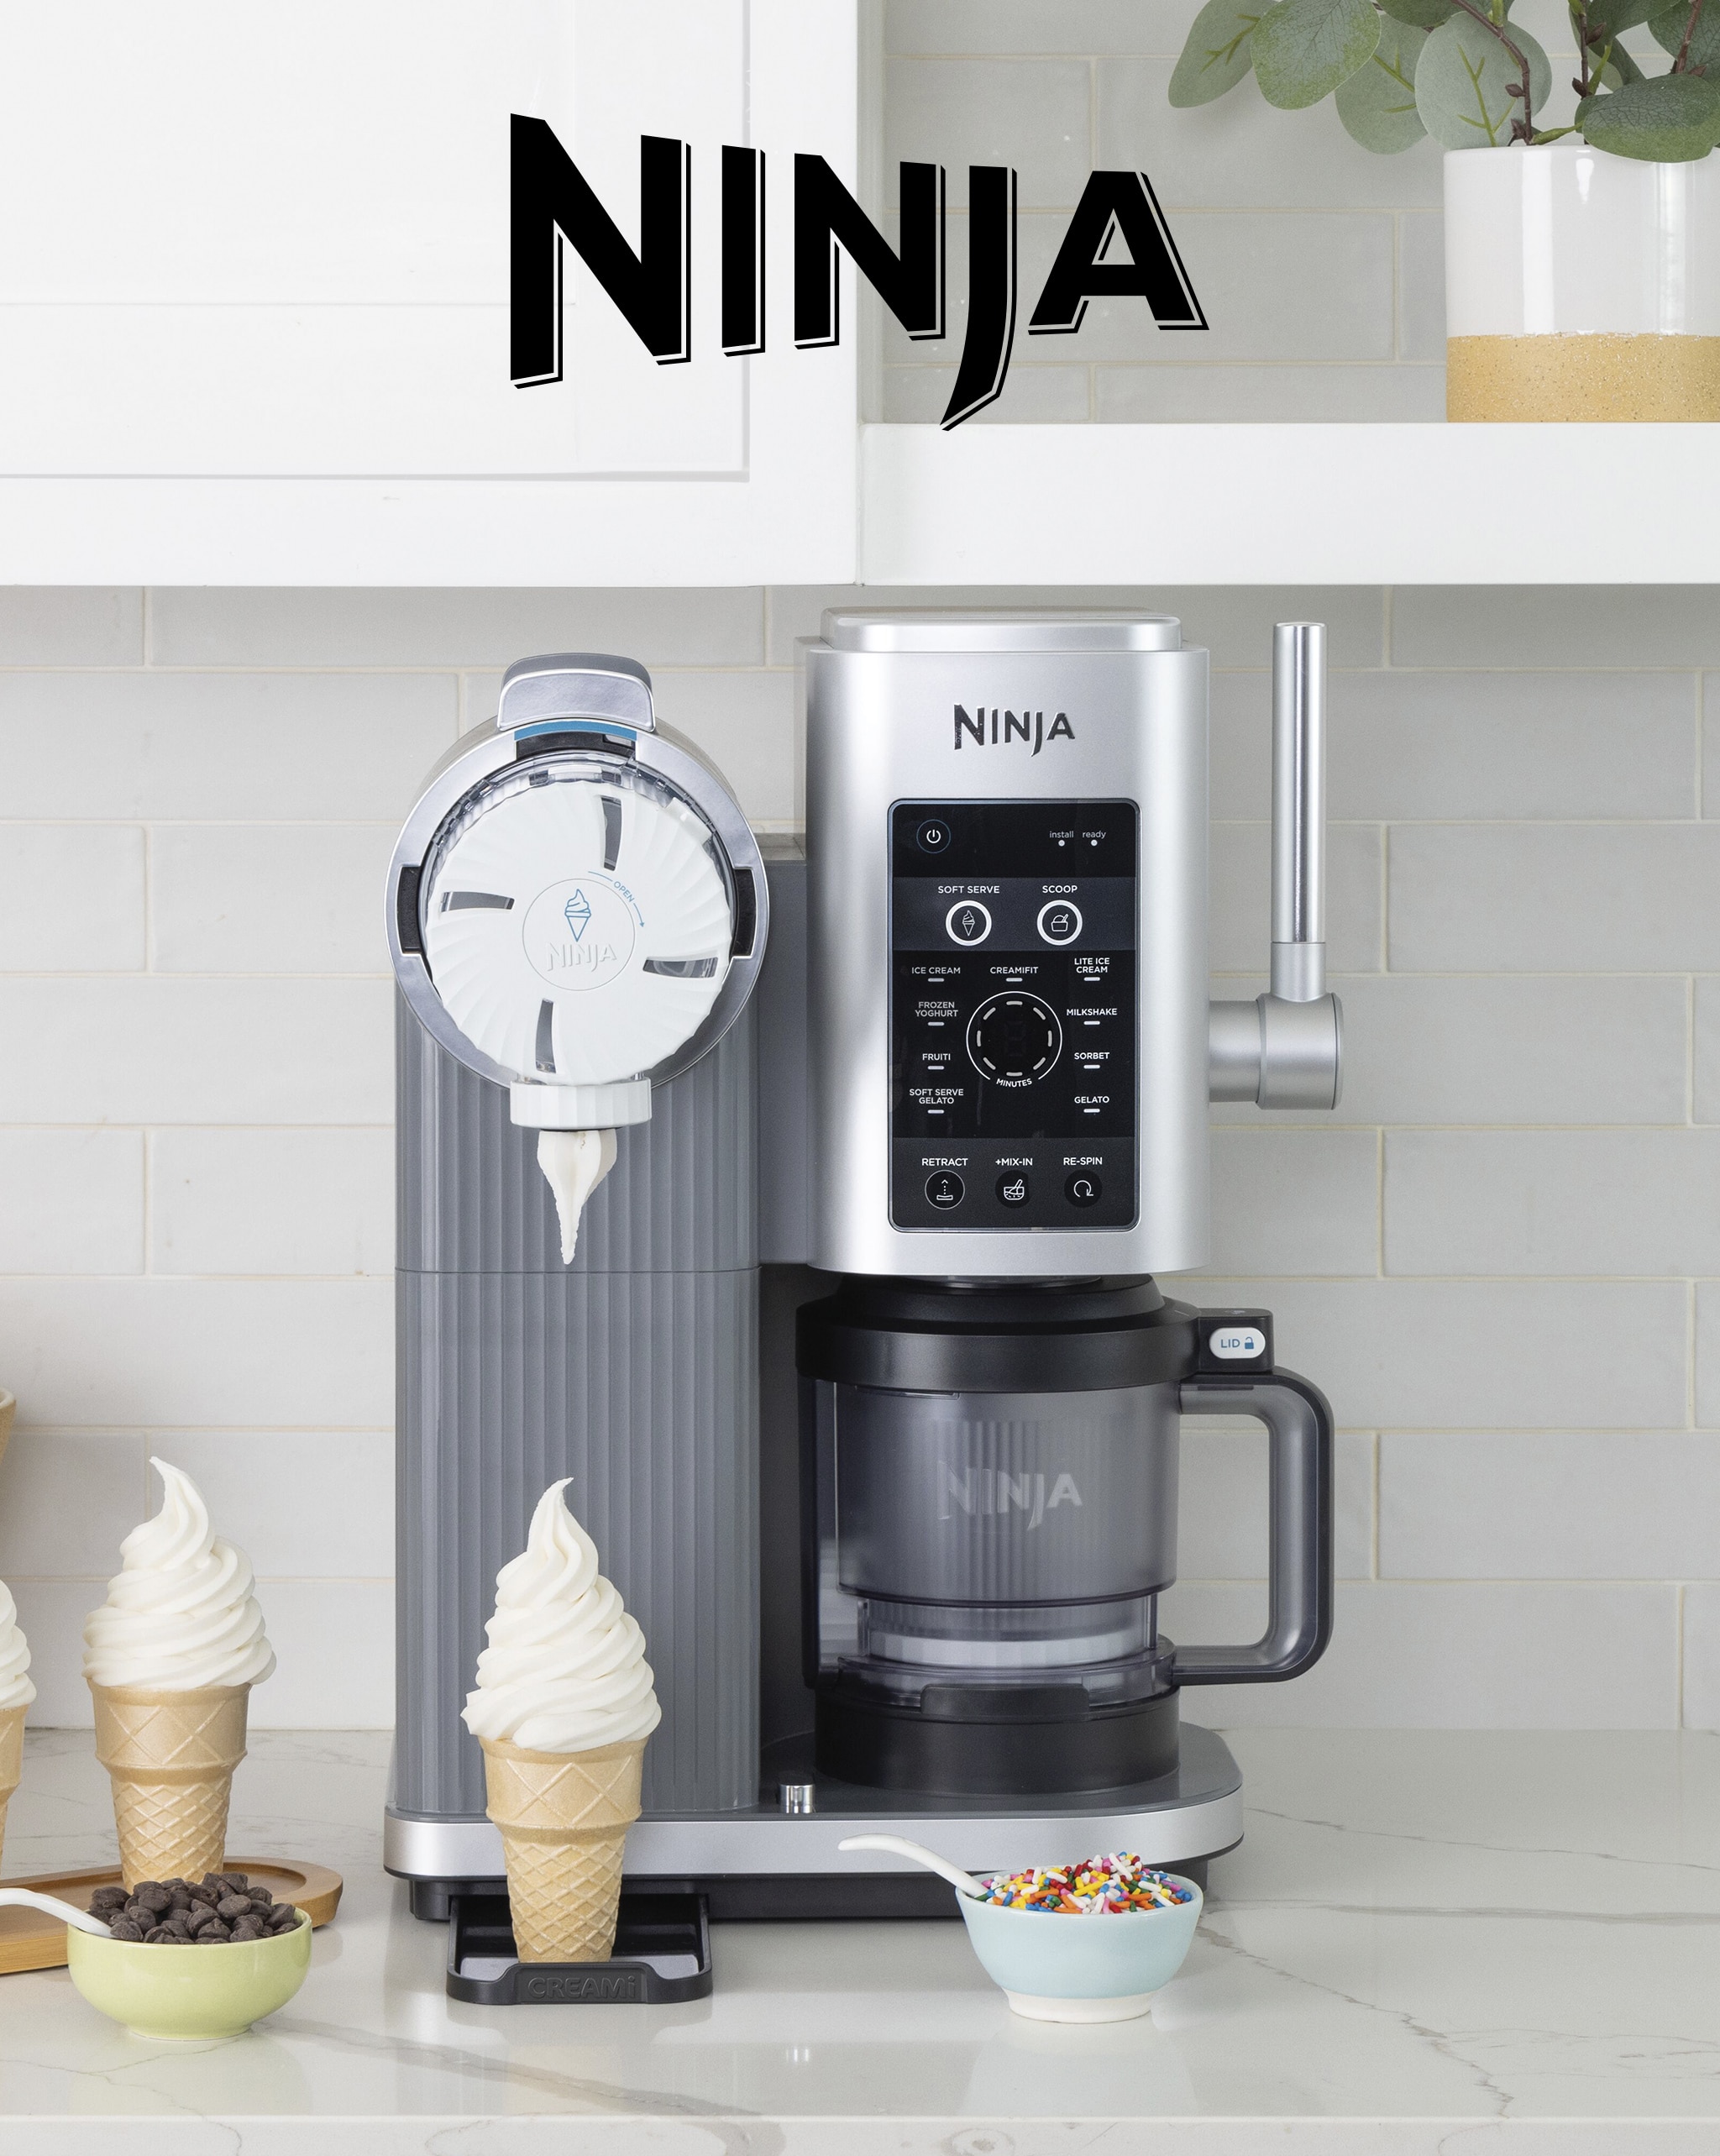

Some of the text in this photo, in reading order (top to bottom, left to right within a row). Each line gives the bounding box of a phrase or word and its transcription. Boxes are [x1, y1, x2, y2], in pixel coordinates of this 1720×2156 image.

[953, 703, 1075, 757] NINJA
[1082, 831, 1106, 840] ready
[613, 881, 635, 903] OPEN
[937, 885, 999, 894] SOFT SERVE
[1042, 885, 1078, 894] SCOOP
[547, 942, 617, 973] NINJA
[996, 1078, 1032, 1088] MINUTES
[921, 1157, 968, 1166] RETRACT
[995, 1157, 1033, 1166] +MIX-IN
[1063, 1157, 1103, 1166] RE-SPIN
[1220, 1339, 1240, 1348] LID
[936, 1460, 1083, 1531] NINJA
